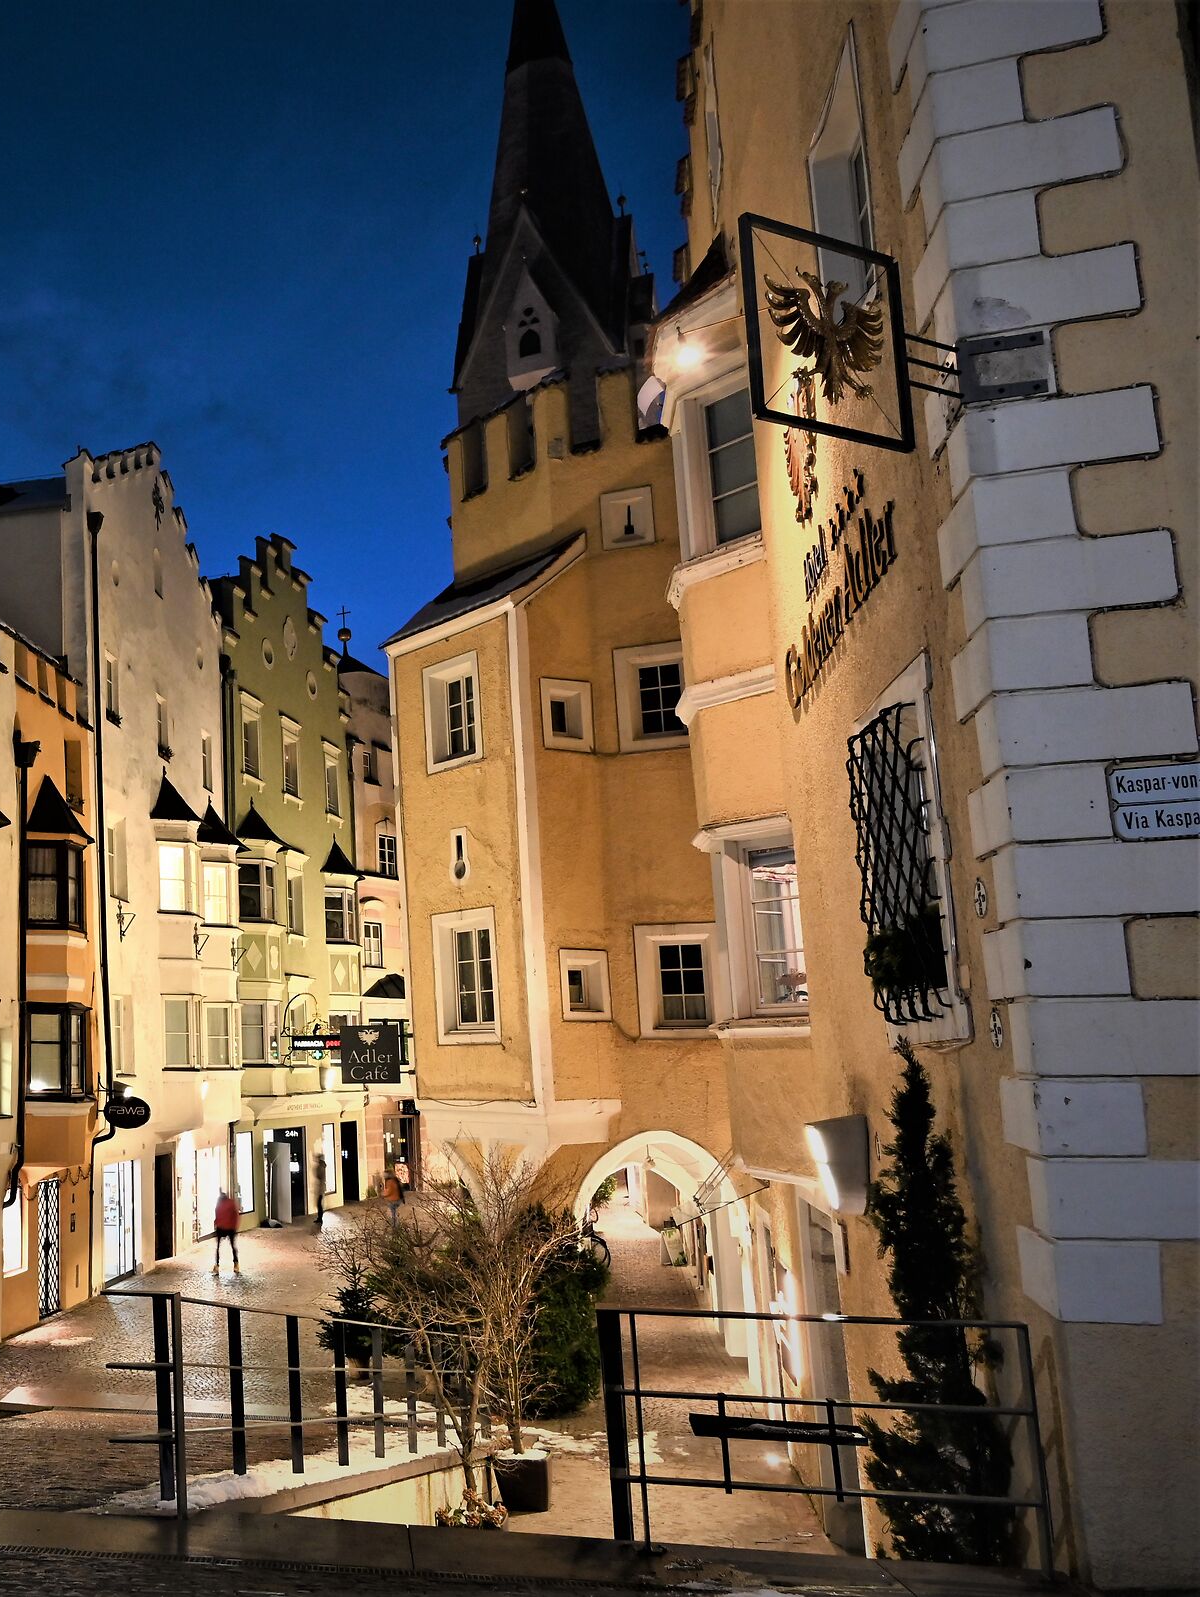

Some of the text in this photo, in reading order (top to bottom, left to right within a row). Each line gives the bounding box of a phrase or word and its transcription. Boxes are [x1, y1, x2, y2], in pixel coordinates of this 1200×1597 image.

[804, 524, 828, 602] Hotel
[844, 500, 898, 625] Adler
[1123, 811, 1150, 830] Via
[348, 1049, 393, 1064] Adler
[350, 1066, 388, 1080] Café
